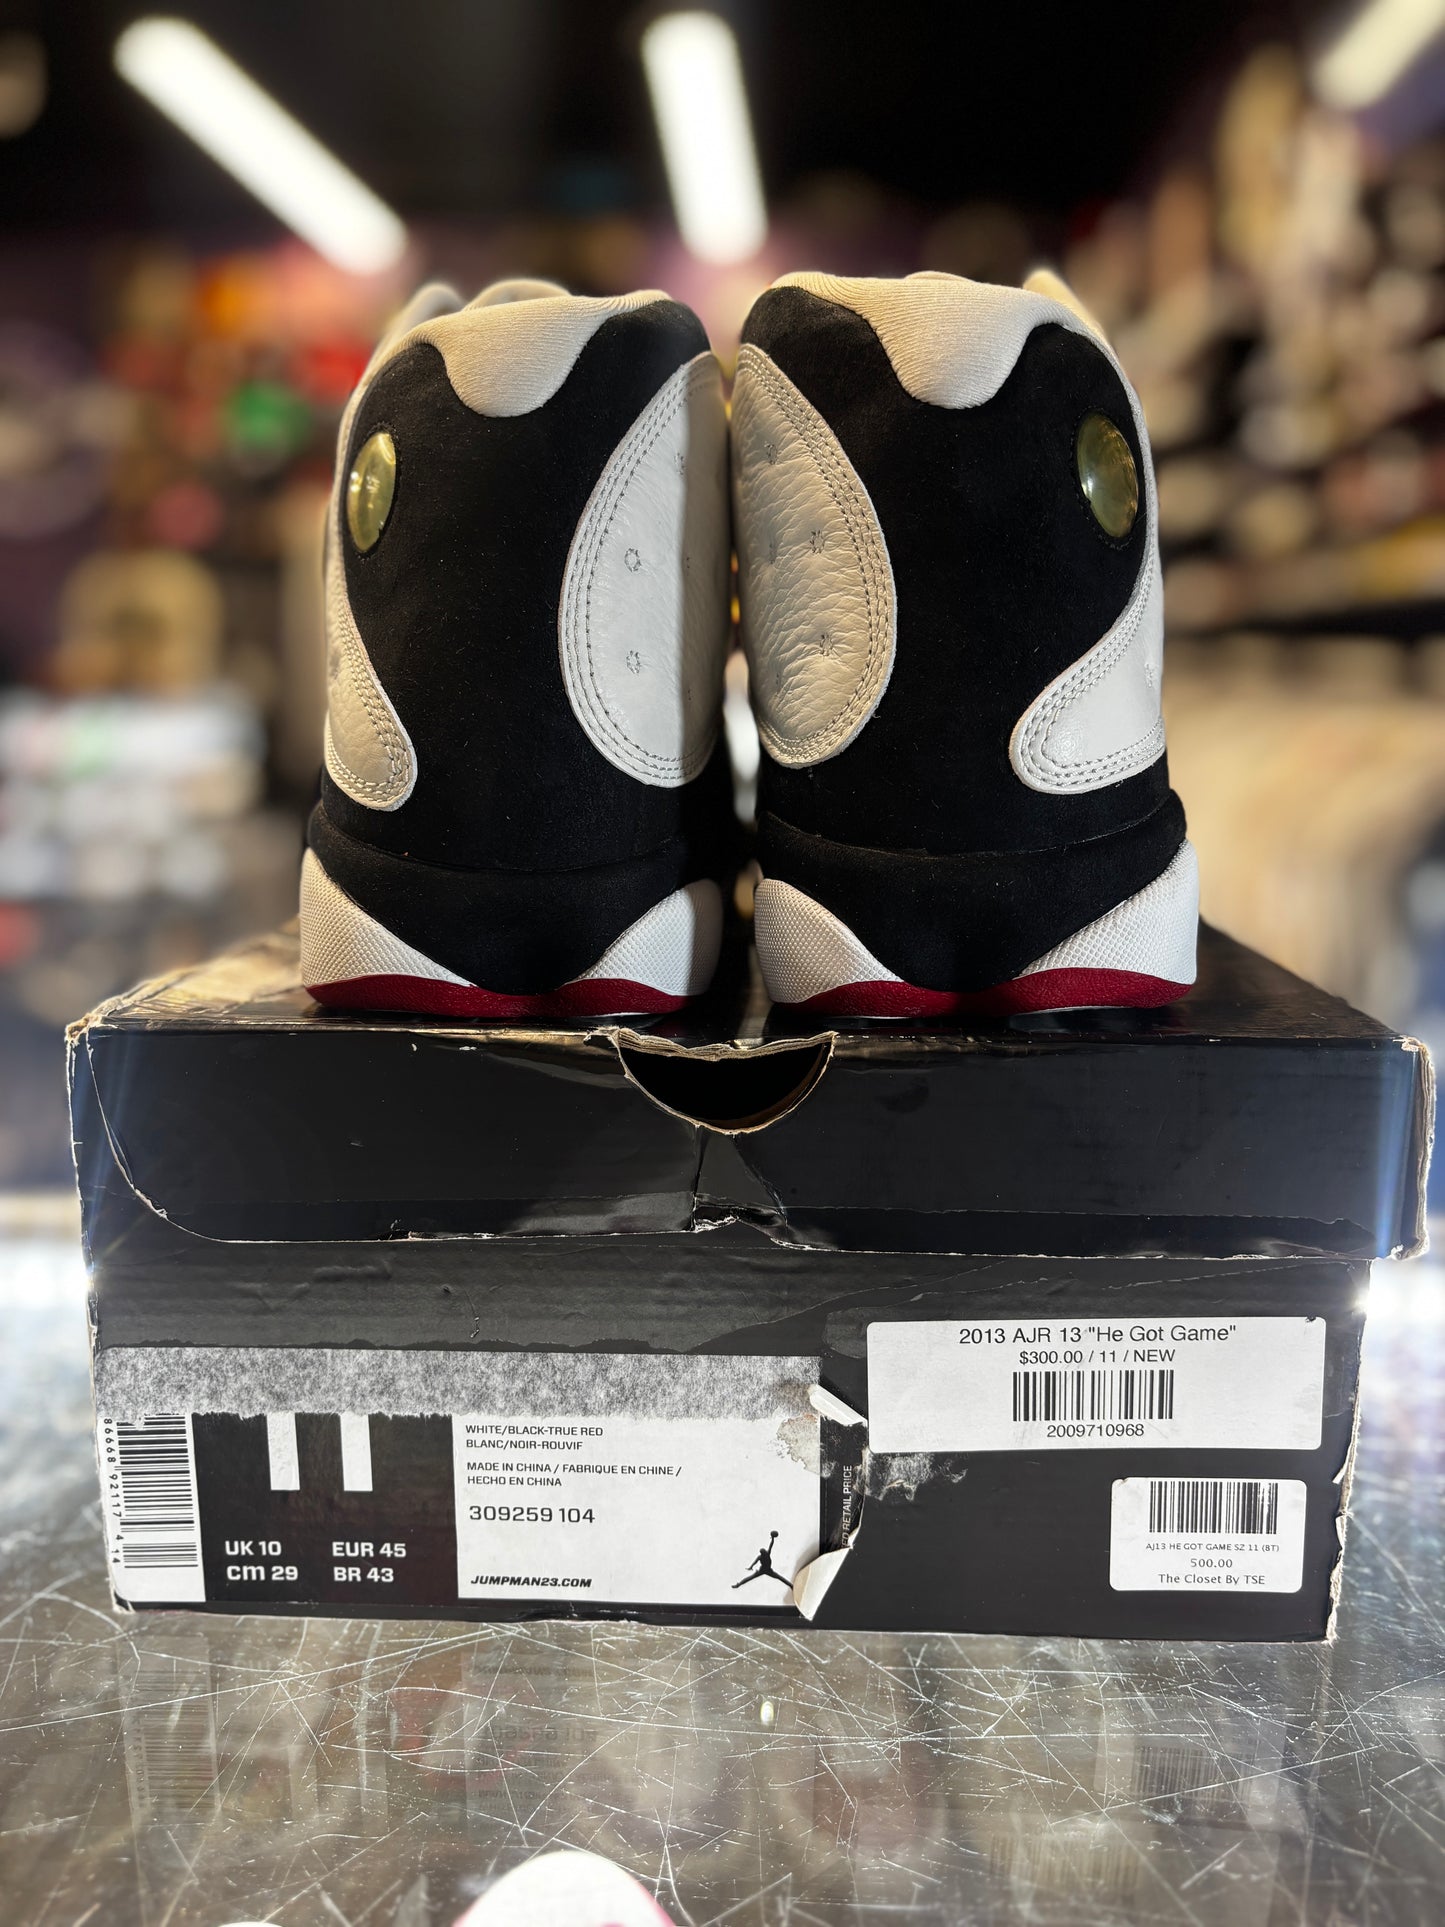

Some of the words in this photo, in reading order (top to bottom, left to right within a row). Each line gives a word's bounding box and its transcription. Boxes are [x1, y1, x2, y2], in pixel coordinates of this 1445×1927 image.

[959, 1328, 1006, 1344] 2013
[1012, 1327, 1051, 1343] AJR
[1060, 1327, 1082, 1343] 13
[1088, 1325, 1123, 1342] "He
[1129, 1325, 1164, 1342] Got
[1170, 1324, 1237, 1341] Game"
[1019, 1350, 1083, 1365] $300.00
[1088, 1350, 1095, 1363] /
[1100, 1350, 1117, 1363] 11
[1123, 1350, 1129, 1363] /
[1133, 1349, 1176, 1363] NEW
[465, 1425, 578, 1436] WHITE/BLACK-TRUE
[580, 1427, 603, 1436] RED
[1046, 1423, 1145, 1438] 2009710968
[466, 1439, 583, 1450] BLANC/NOIR-ROUVIF
[467, 1462, 499, 1472] MADE
[502, 1463, 513, 1472] IN
[516, 1463, 551, 1473] CHINA
[553, 1464, 559, 1474] /
[562, 1464, 618, 1475] FABRIQUE
[621, 1465, 635, 1475] EN
[638, 1466, 674, 1475] CHINE
[675, 1466, 682, 1477] /
[467, 1476, 506, 1485] HECHO
[509, 1476, 524, 1486] EN
[527, 1477, 562, 1486] CHINA
[843, 1465, 852, 1494] PRICE
[109, 1474, 122, 1517] 92117
[469, 1505, 553, 1522] 309259
[558, 1507, 595, 1523] 104
[842, 1496, 852, 1530] RETAIL
[225, 1540, 254, 1556] UK
[258, 1540, 282, 1556] 10
[332, 1541, 374, 1557] EUR
[379, 1542, 407, 1557] 45
[1145, 1543, 1166, 1551] AJ13
[1205, 1543, 1232, 1551] GAME
[1234, 1543, 1245, 1551] SZ
[1190, 1558, 1233, 1568] 500.00
[271, 1565, 298, 1581] 29
[333, 1566, 361, 1582] BR
[366, 1567, 394, 1582] 43
[1158, 1574, 1180, 1584] The
[1184, 1574, 1222, 1584] Closet
[1226, 1574, 1240, 1585] By
[1243, 1575, 1266, 1585] TSE
[471, 1575, 592, 1588] JUMPMAN23.COM
